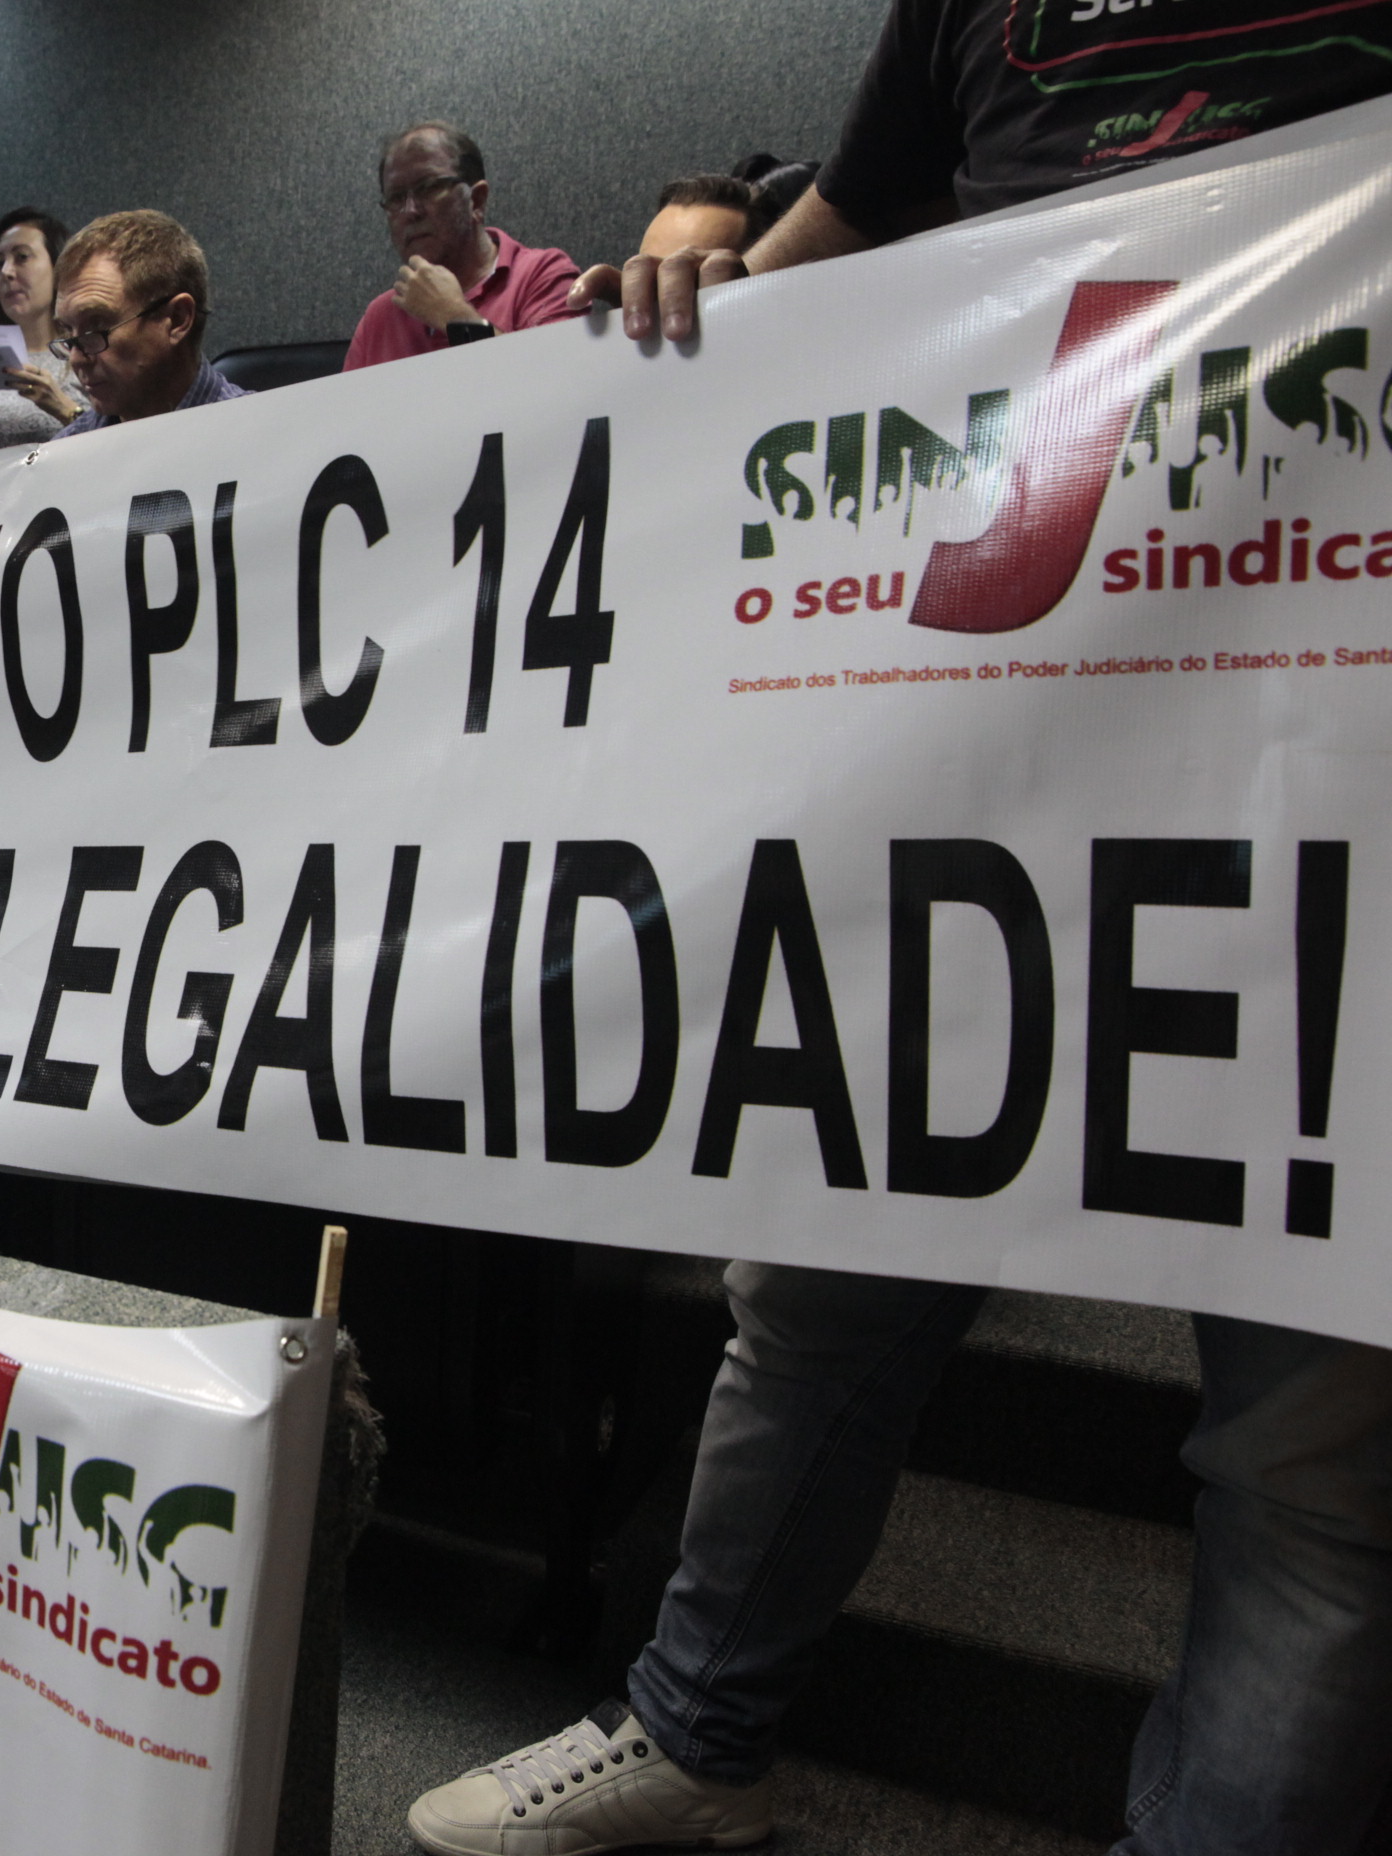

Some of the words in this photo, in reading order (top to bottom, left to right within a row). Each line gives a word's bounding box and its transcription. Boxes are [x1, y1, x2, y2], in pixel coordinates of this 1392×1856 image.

[741, 281, 1392, 634] SINJUS
[125, 455, 389, 753] PLC
[453, 416, 615, 733] 14
[734, 586, 773, 625] o
[793, 570, 906, 620] seu
[728, 676, 802, 694] Sindicato
[806, 672, 837, 690] dos
[840, 664, 973, 687] Trabalhadores
[976, 662, 1004, 681] do
[1007, 659, 1069, 680] Poder
[1074, 656, 1174, 678] Judiciário
[1179, 654, 1208, 673] do
[1213, 650, 1291, 672] Estado
[1296, 649, 1327, 669] de
[23, 1673, 37, 1690] do
[38, 1681, 75, 1717] Estado
[77, 1708, 92, 1727] de
[94, 1717, 135, 1747] Santa
[139, 1736, 213, 1770] Catarina.
